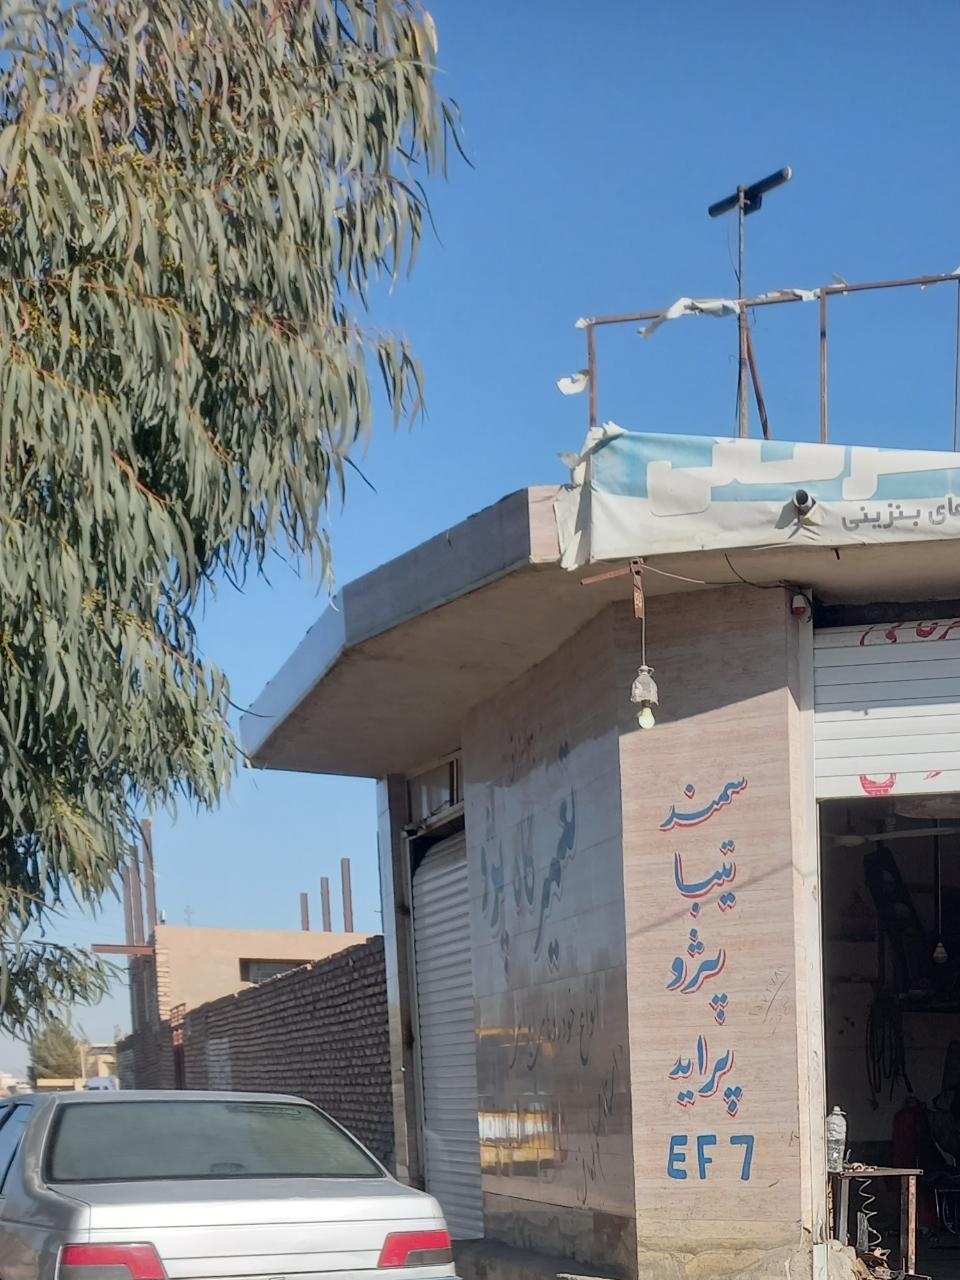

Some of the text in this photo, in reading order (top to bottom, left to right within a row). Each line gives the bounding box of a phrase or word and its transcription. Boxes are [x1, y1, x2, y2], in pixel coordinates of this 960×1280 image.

[841, 503, 921, 532] بنزینی
[658, 776, 748, 832] سمند
[674, 839, 737, 918] تیبا
[665, 927, 729, 1026] پژو
[668, 1034, 744, 1118] پراید
[667, 1133, 756, 1182] EF7
